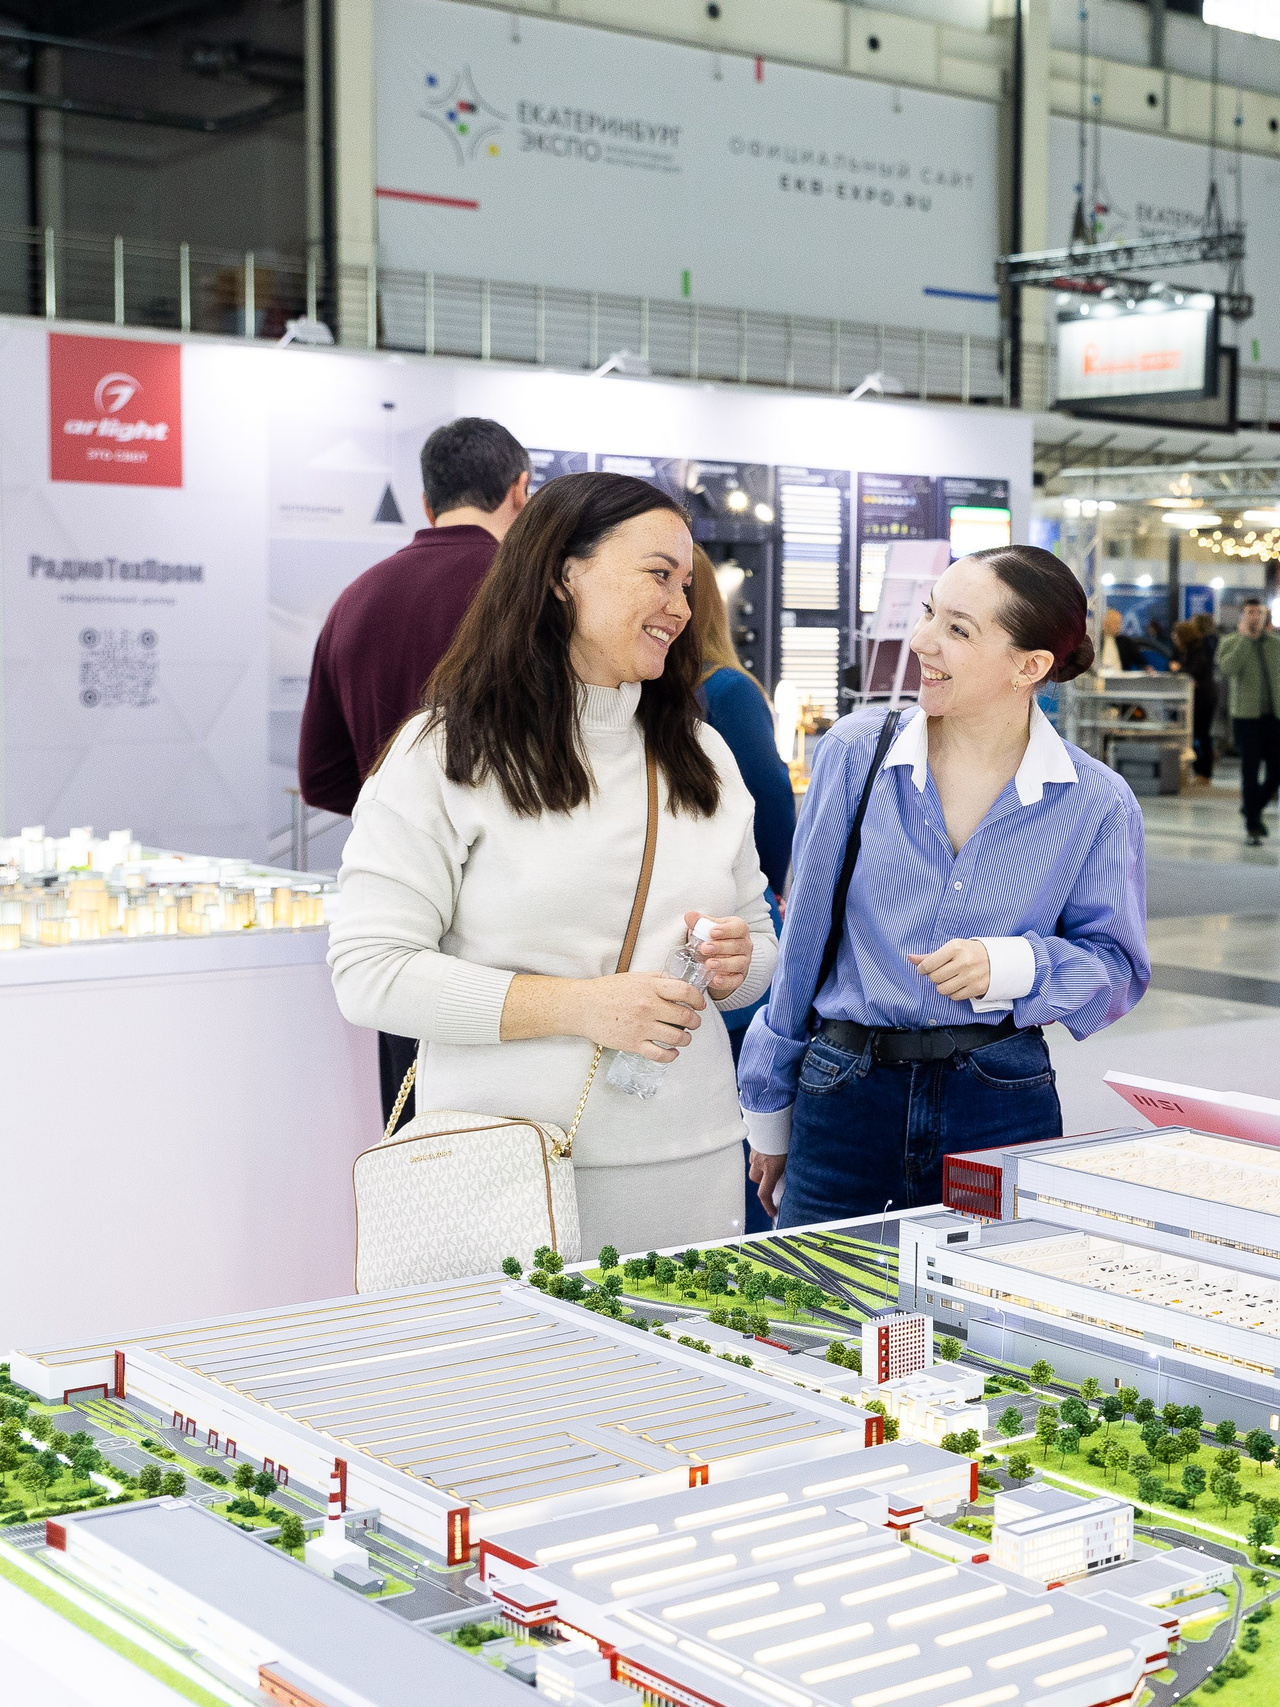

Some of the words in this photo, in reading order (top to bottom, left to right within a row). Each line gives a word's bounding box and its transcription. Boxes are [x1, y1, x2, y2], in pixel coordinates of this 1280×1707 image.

[517, 100, 681, 147] ЕКАТЕРИНБУРГ
[519, 127, 602, 163] ЭКСПО
[728, 136, 911, 180] ОФИЦИАЛЬНЫЙ
[919, 164, 975, 190] САЙТ
[63, 417, 169, 442] arlight
[28, 553, 205, 584] РадиоТехПром
